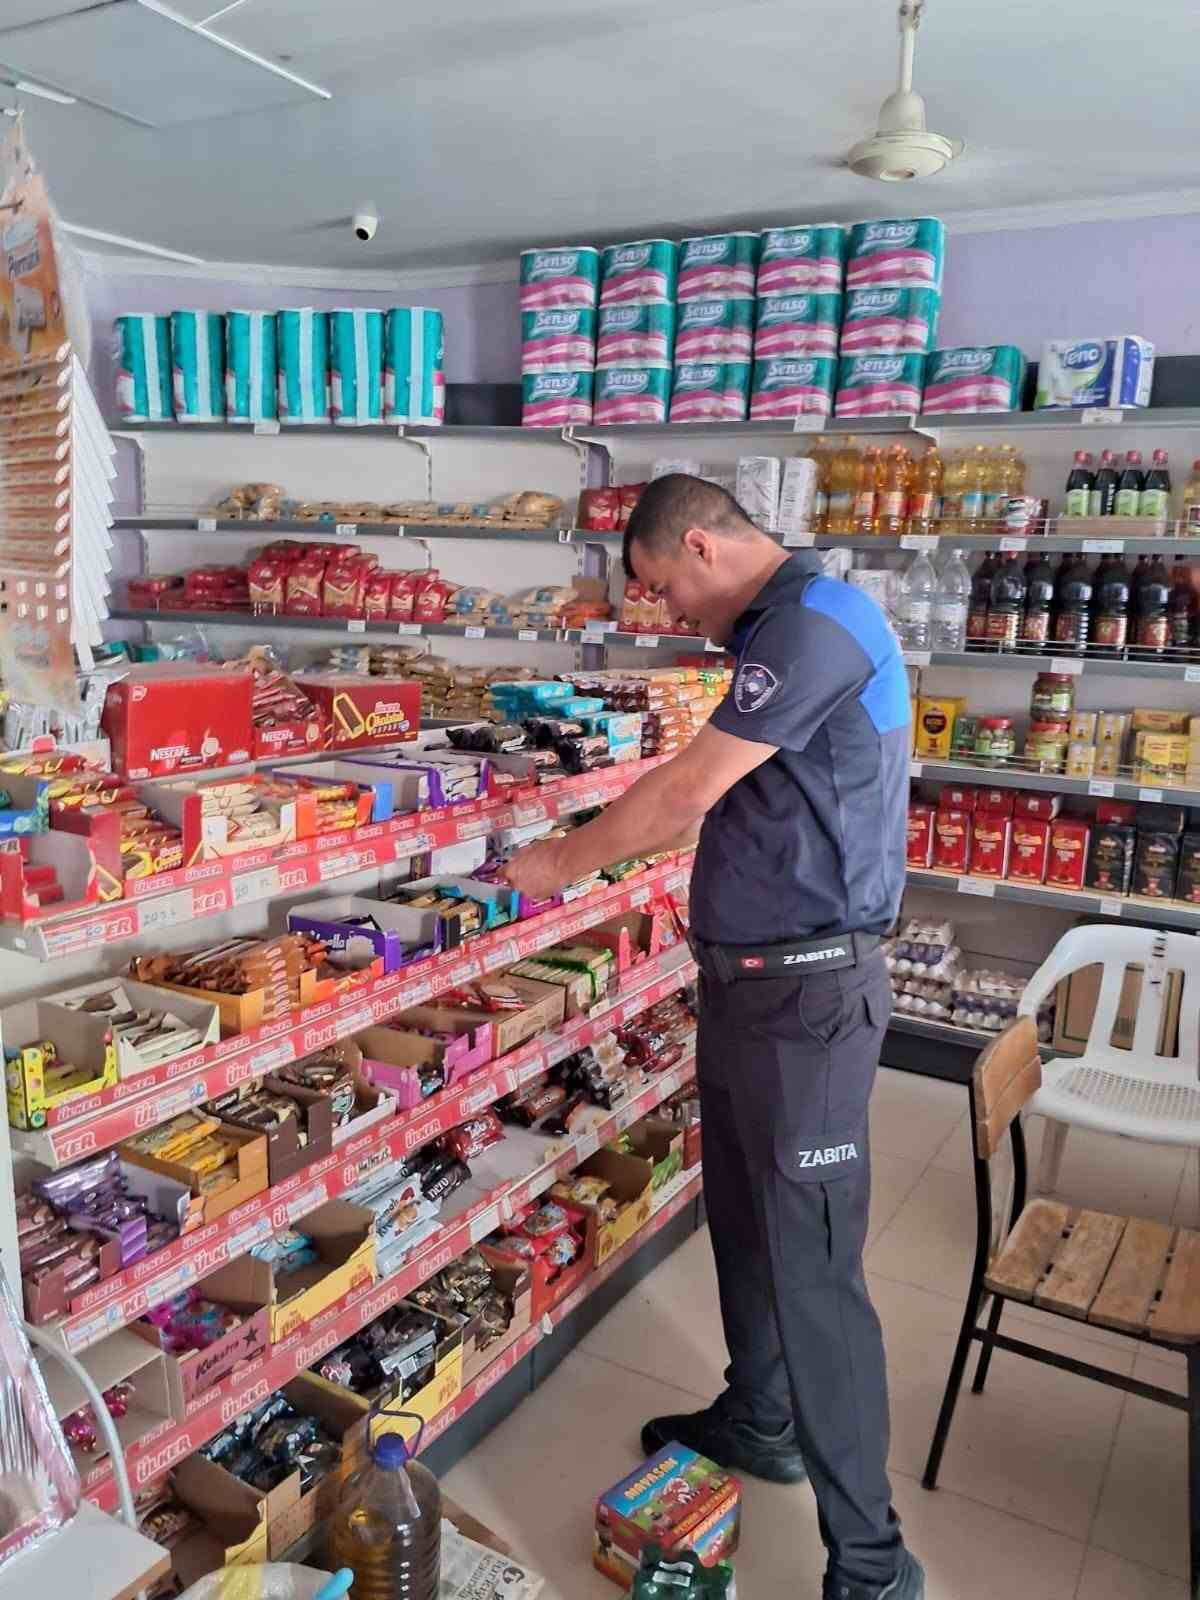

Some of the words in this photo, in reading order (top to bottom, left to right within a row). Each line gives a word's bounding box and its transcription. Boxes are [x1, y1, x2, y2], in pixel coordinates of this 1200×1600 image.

[865, 224, 915, 243] Senso
[687, 240, 728, 258] Senso
[768, 234, 810, 251] Senso
[535, 254, 578, 269] Senso
[612, 247, 649, 264] Senso
[766, 298, 808, 316] Senso
[852, 293, 899, 309] Senso
[536, 312, 578, 327] Senso
[686, 303, 724, 320] Senso
[854, 358, 902, 376] Senso
[942, 350, 994, 368] Senso
[679, 366, 719, 383] Senso
[769, 359, 813, 378] Senso
[535, 376, 578, 392] Senso
[607, 372, 648, 388] Senso
[783, 946, 847, 965] ZABITA
[799, 1143, 857, 1168] ZABITA
